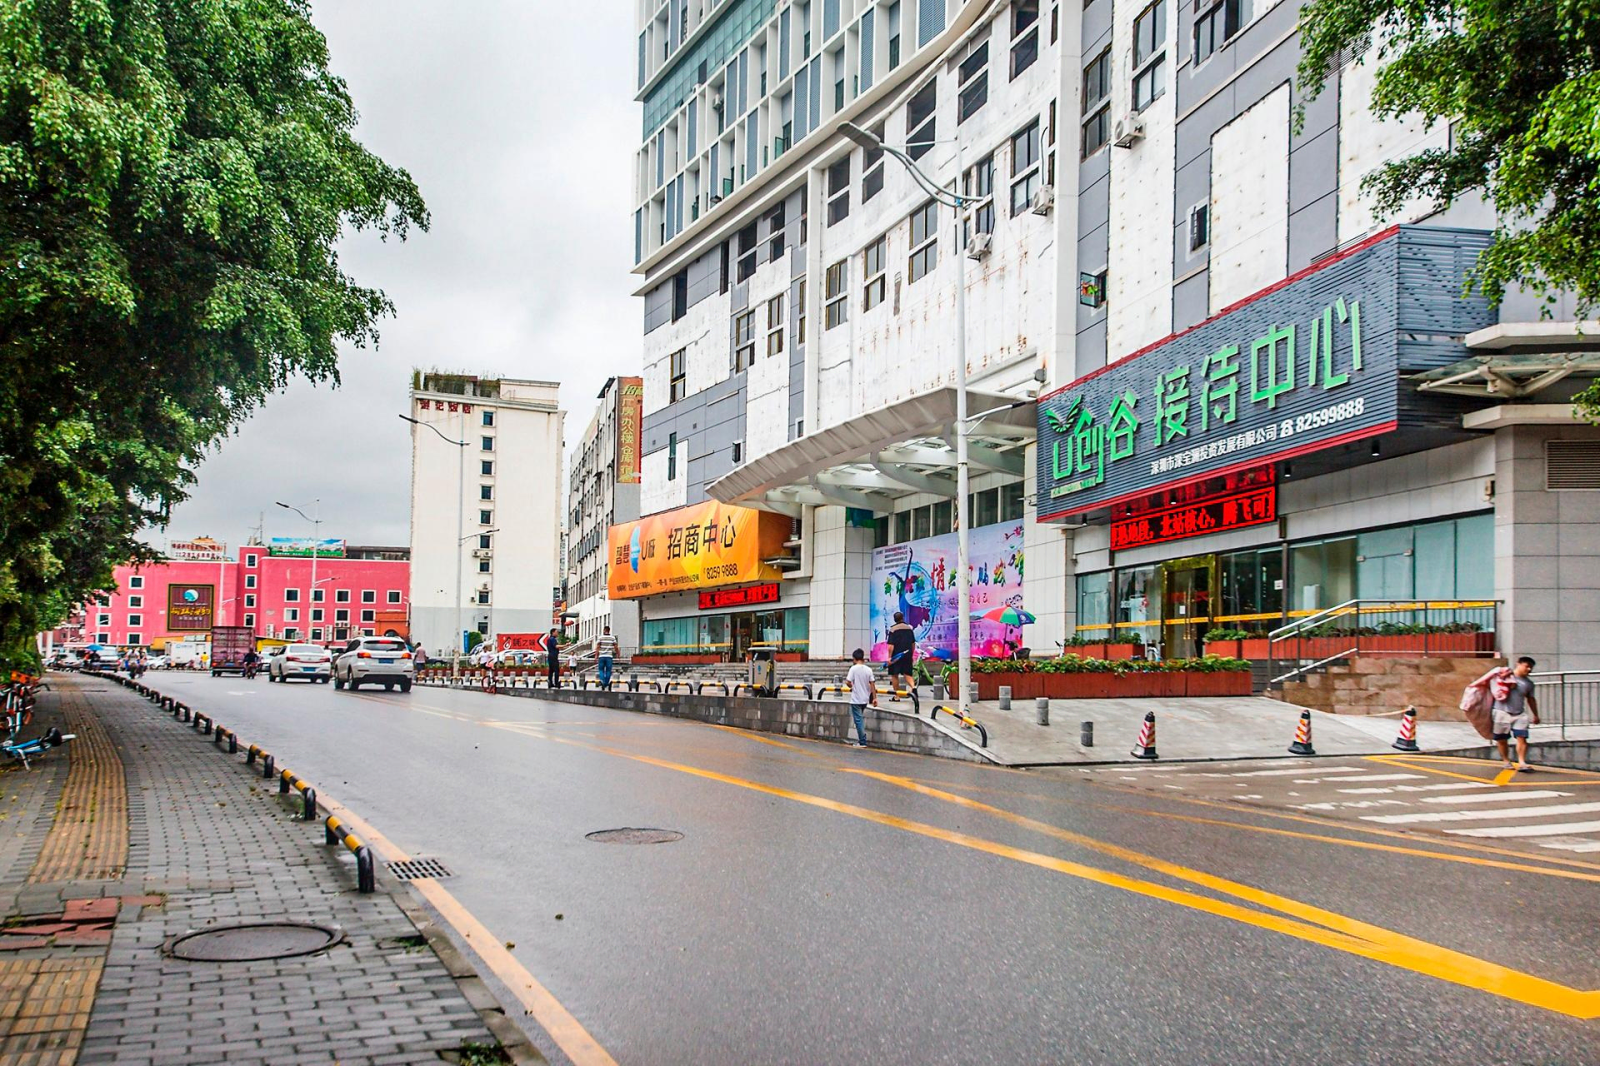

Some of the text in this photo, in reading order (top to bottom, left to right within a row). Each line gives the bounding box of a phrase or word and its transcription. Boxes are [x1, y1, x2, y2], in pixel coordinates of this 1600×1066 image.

[1153, 296, 1364, 447] 接待中心
[1295, 396, 1365, 433] 82599888
[667, 514, 737, 561] 招商中心
